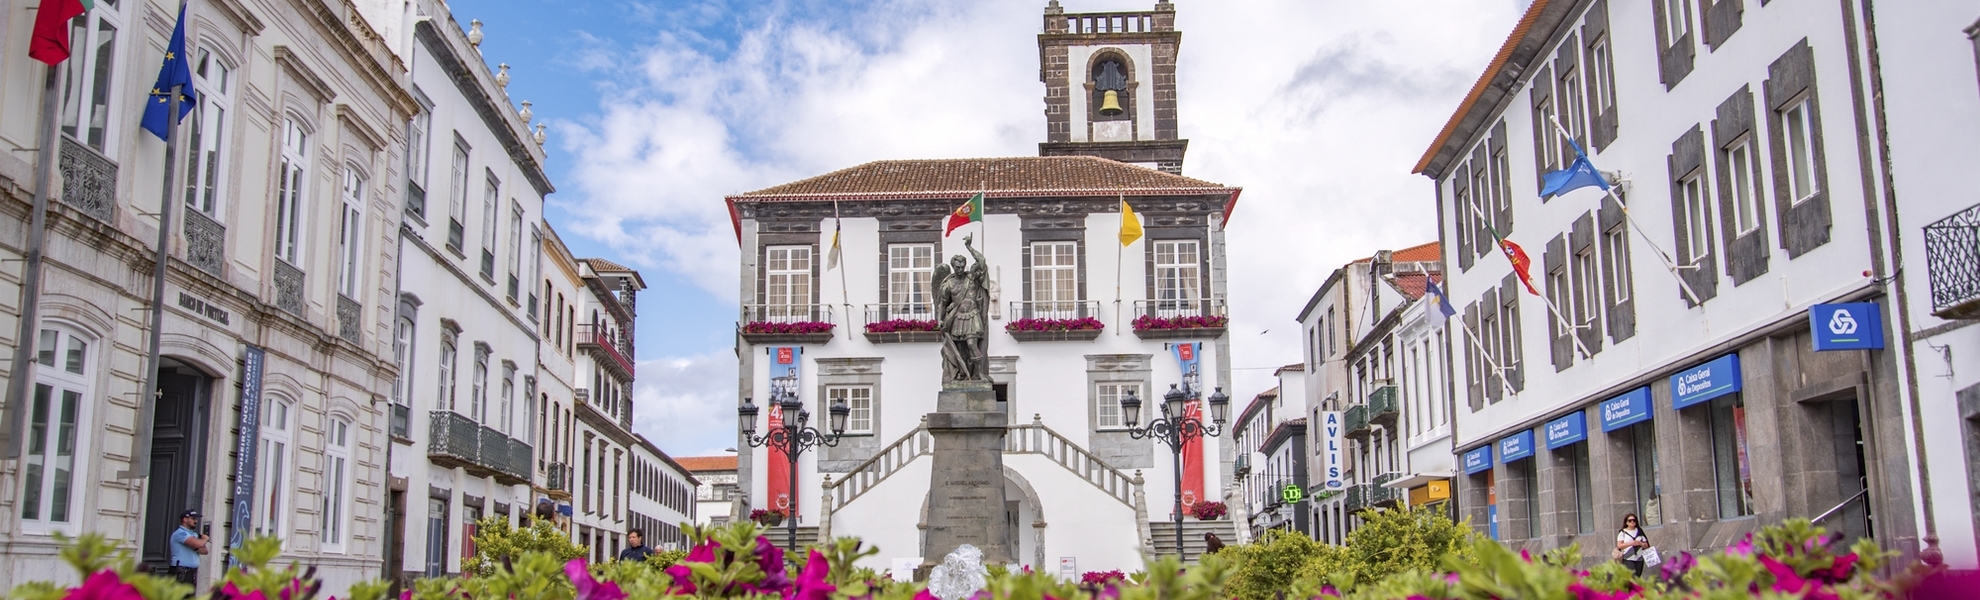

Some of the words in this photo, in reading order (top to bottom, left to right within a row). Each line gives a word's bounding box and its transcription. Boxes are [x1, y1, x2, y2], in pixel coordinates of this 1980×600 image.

[179, 292, 196, 311] BANCO
[196, 299, 204, 315] DE
[204, 302, 230, 326] PORTUGAL
[1686, 373, 1698, 384] Caixa
[1698, 367, 1710, 379] Geral
[1692, 380, 1711, 393] Depositos
[1611, 402, 1620, 411] Caixa
[1620, 397, 1629, 408] Geral
[238, 426, 246, 483] DINHEIRO
[244, 352, 253, 396] AÇORES
[248, 413, 252, 425] IN
[1328, 414, 1338, 478] AVLIS
